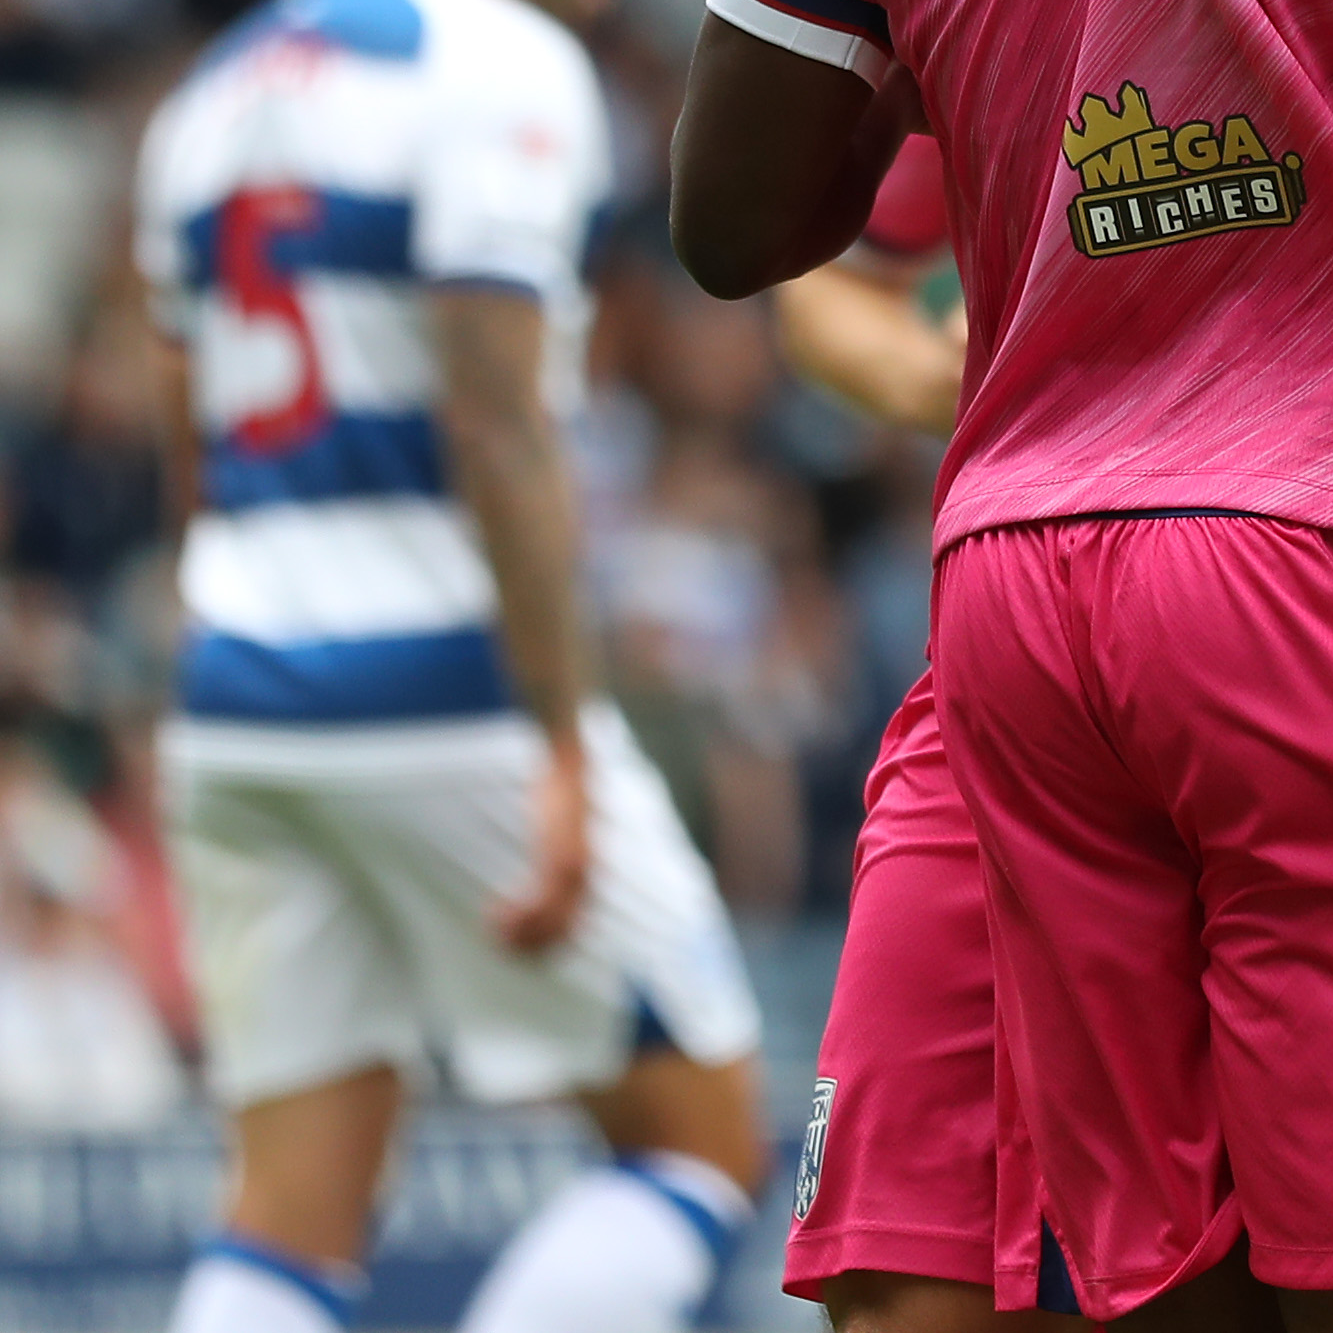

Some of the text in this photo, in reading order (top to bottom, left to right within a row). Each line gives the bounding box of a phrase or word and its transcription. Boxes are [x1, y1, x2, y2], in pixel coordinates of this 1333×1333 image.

[1081, 115, 1272, 190] MEGA
[1088, 177, 1279, 244] RICHES
[213, 182, 338, 462] 5
